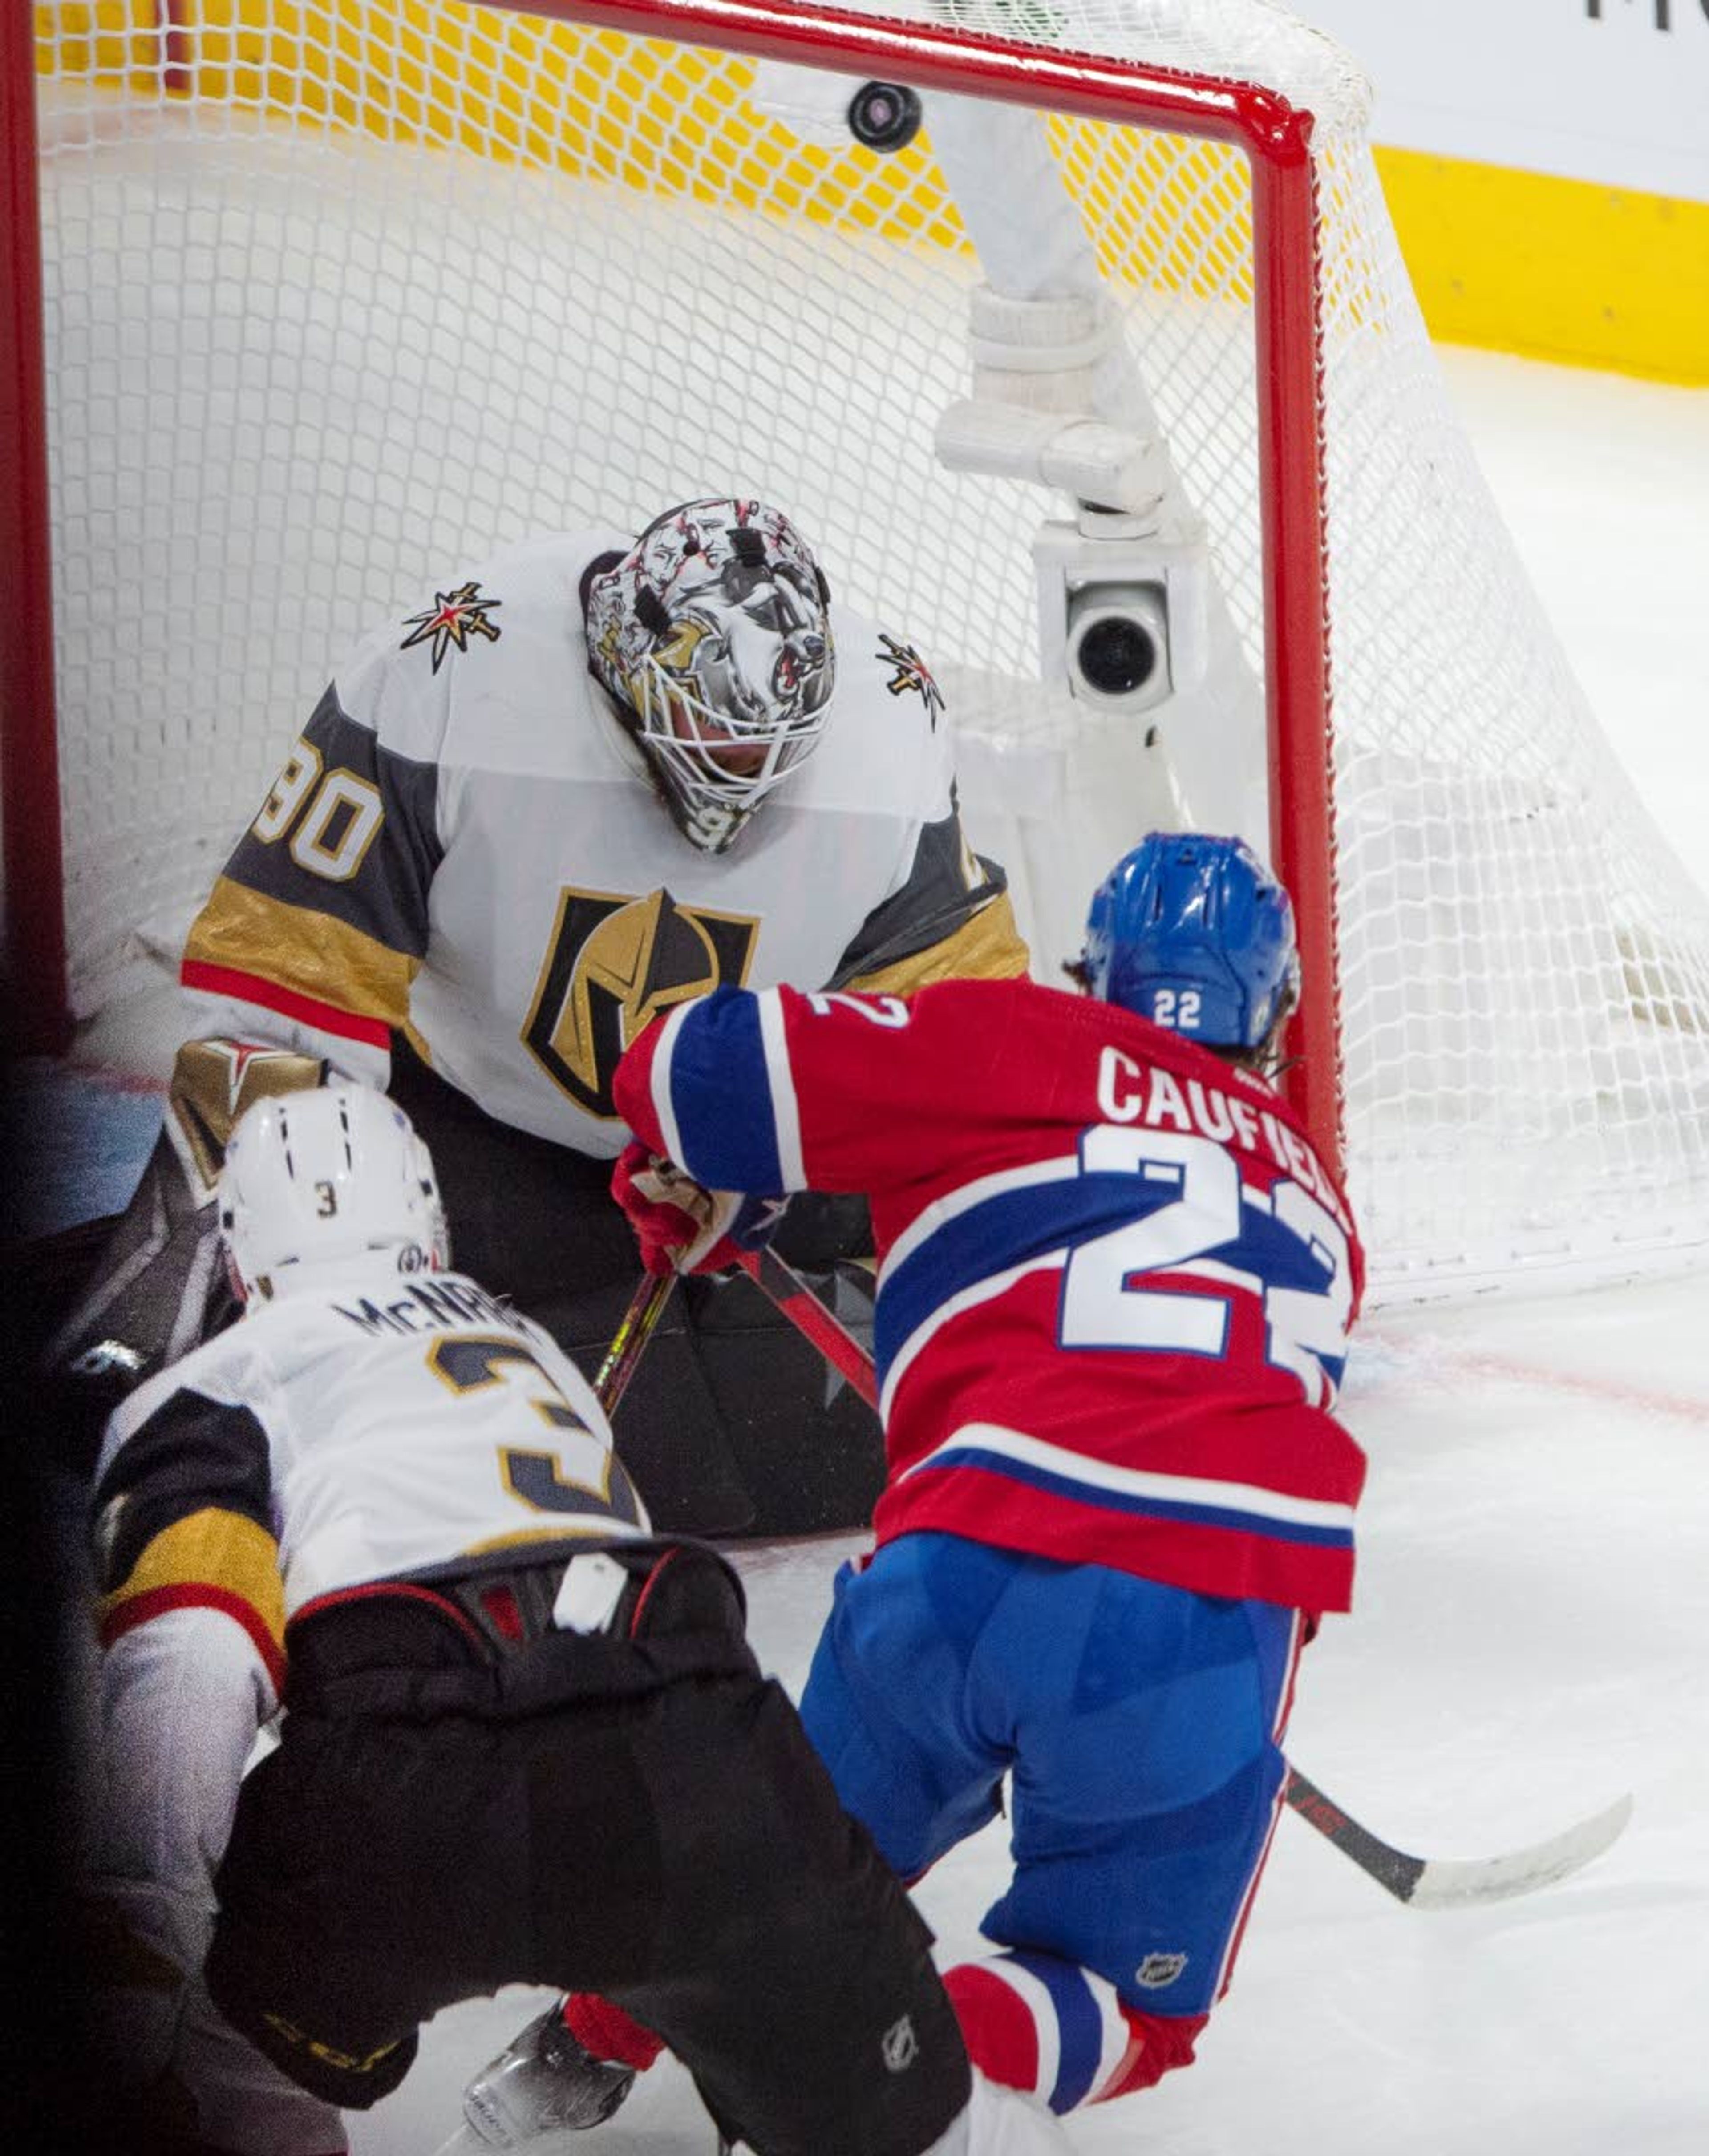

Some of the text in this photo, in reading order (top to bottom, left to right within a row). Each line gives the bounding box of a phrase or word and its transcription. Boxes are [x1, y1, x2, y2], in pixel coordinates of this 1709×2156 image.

[1154, 990, 1200, 1028] 22
[314, 1180, 338, 1218] 3
[1097, 1045, 1352, 1236] CAUFIEL
[1057, 1123, 1355, 1410] 22
[424, 1334, 643, 1527] 3
